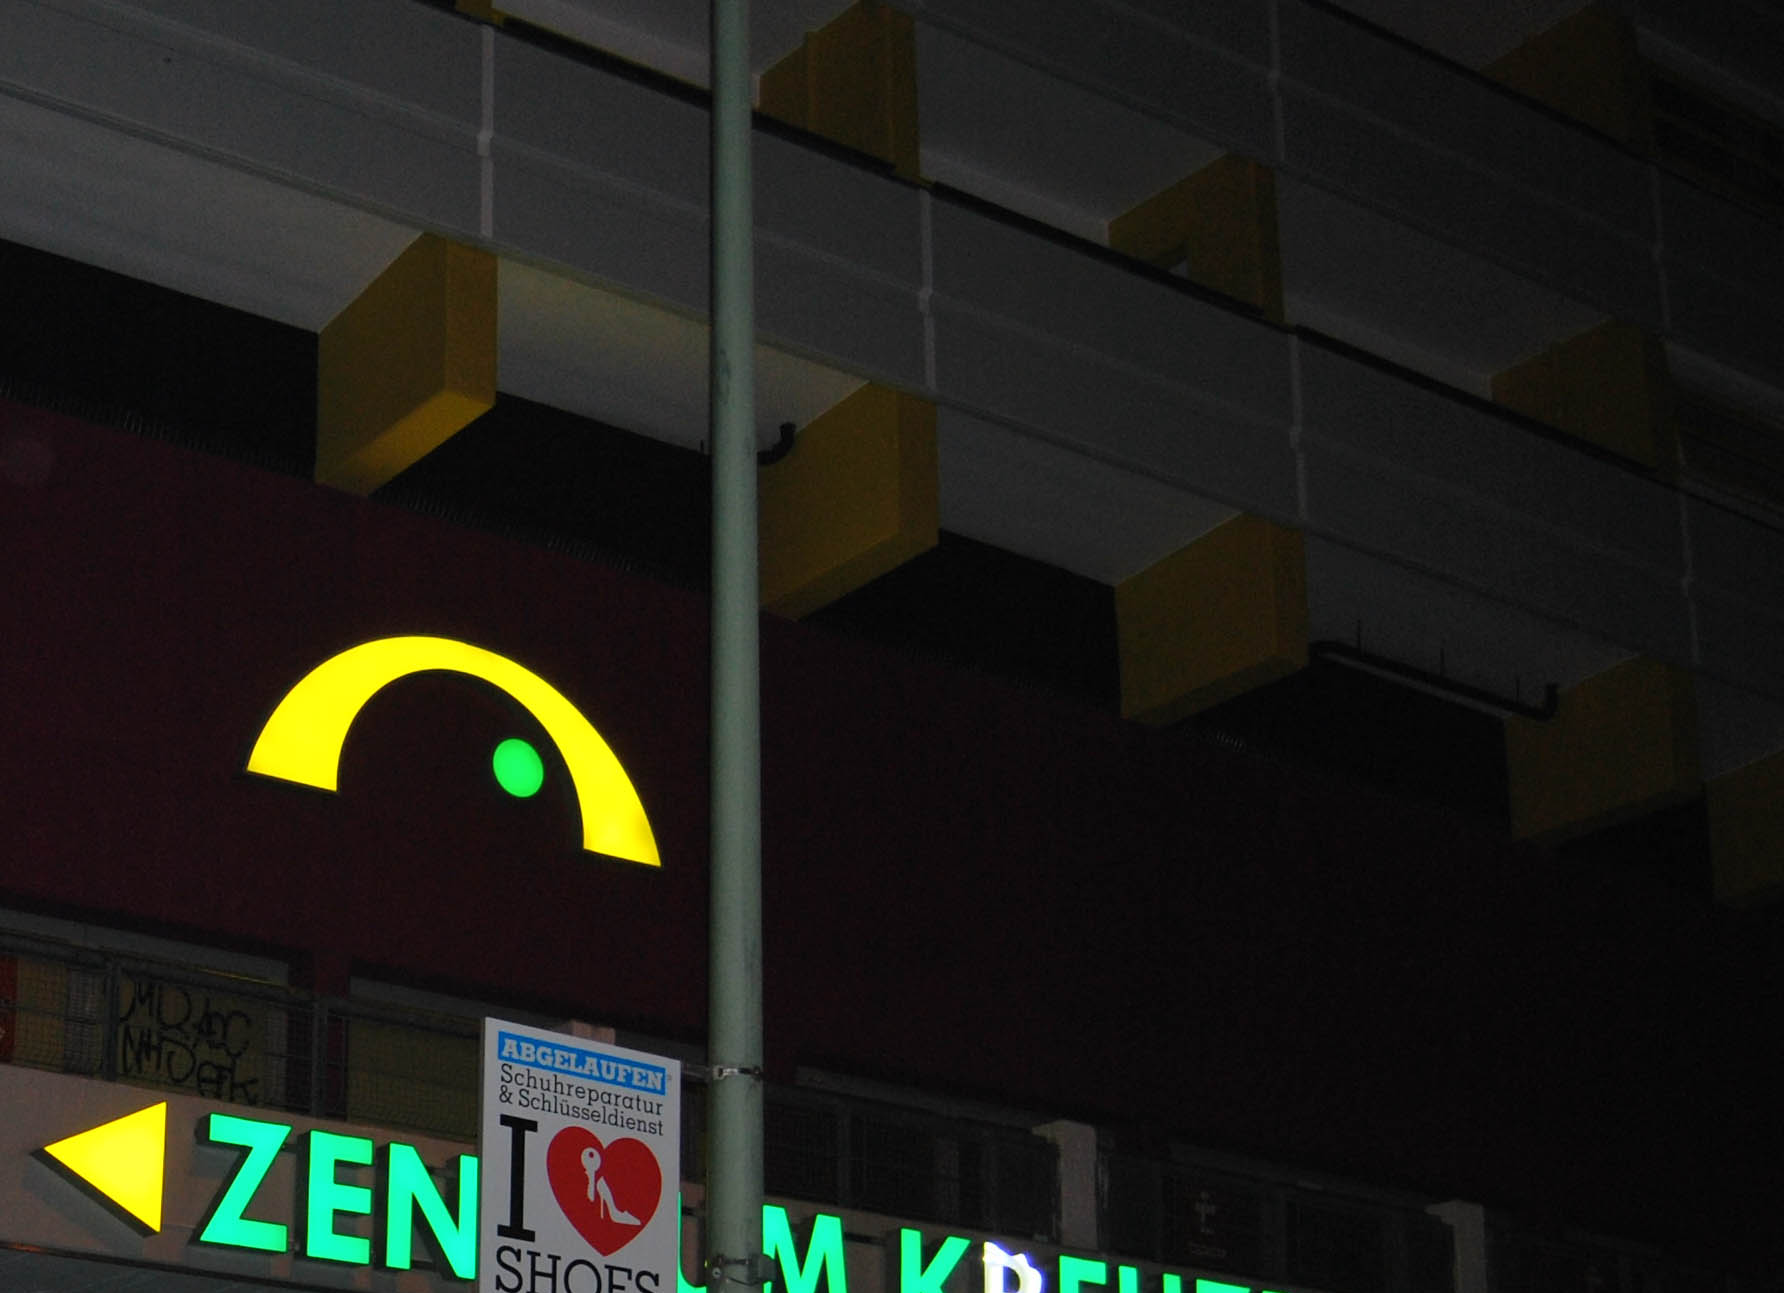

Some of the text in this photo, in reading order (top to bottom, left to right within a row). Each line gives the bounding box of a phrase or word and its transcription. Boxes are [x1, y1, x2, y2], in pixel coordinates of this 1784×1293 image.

[499, 1035, 665, 1092] ABGELAUFEN
[500, 1063, 664, 1116] Schuhreparatur
[499, 1084, 665, 1137] & Schlüsseldienst
[497, 1113, 539, 1243] I
